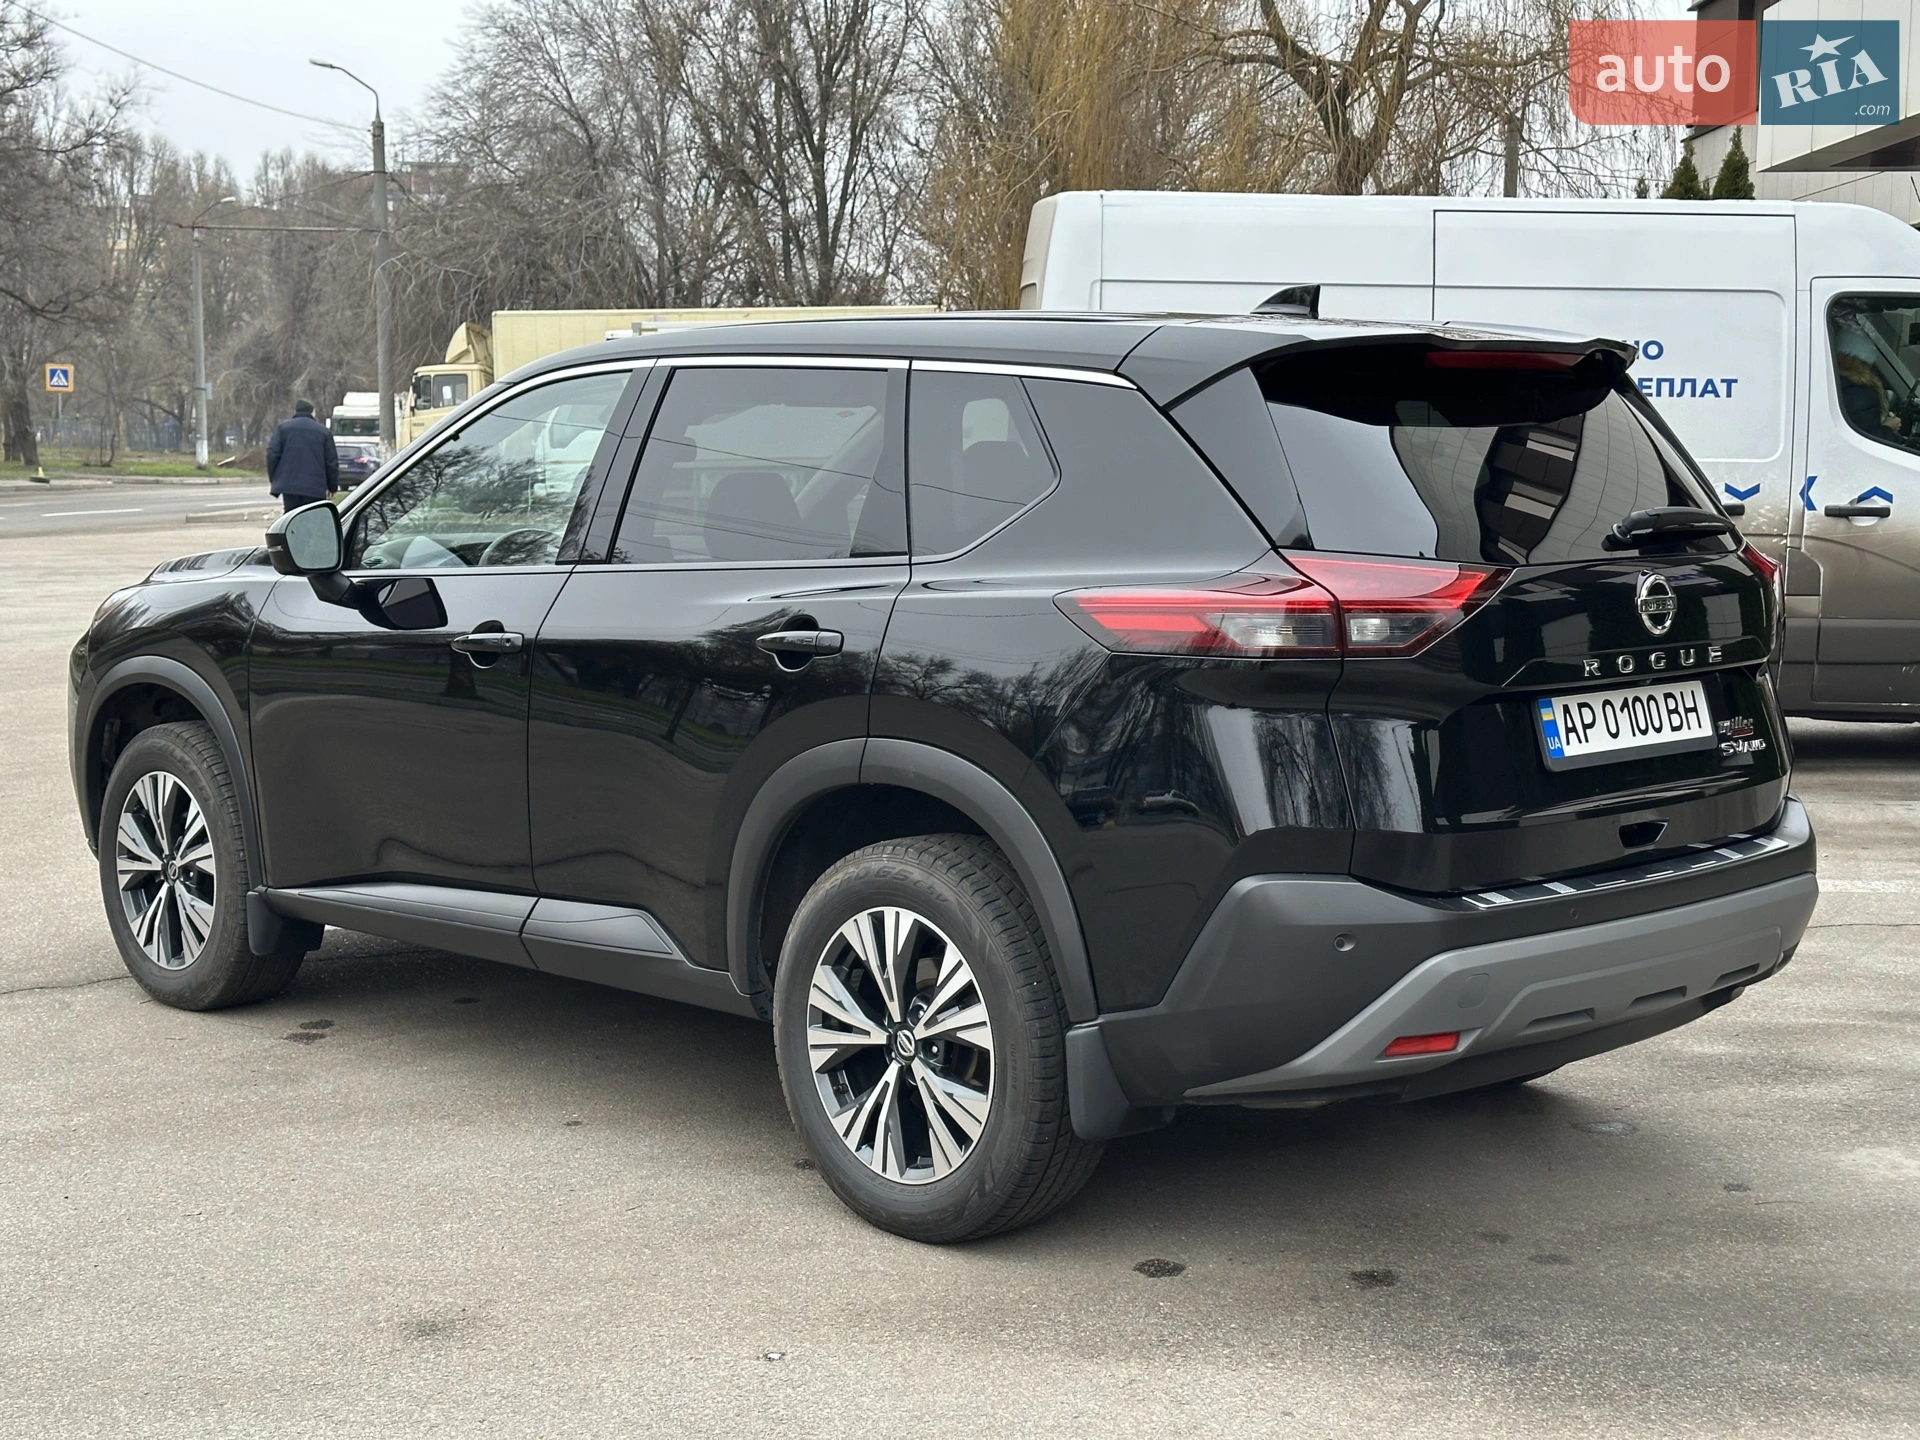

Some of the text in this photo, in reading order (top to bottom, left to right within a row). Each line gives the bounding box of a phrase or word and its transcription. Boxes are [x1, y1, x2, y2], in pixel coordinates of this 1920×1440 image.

[1637, 377, 1738, 398] ЕПЛАТ
[1640, 598, 1676, 612] NISSAN
[1583, 645, 1723, 678] ROGUE
[1562, 690, 1702, 746] AP 0100 BH
[1547, 736, 1562, 751] UA
[912, 879, 950, 904] CSV
